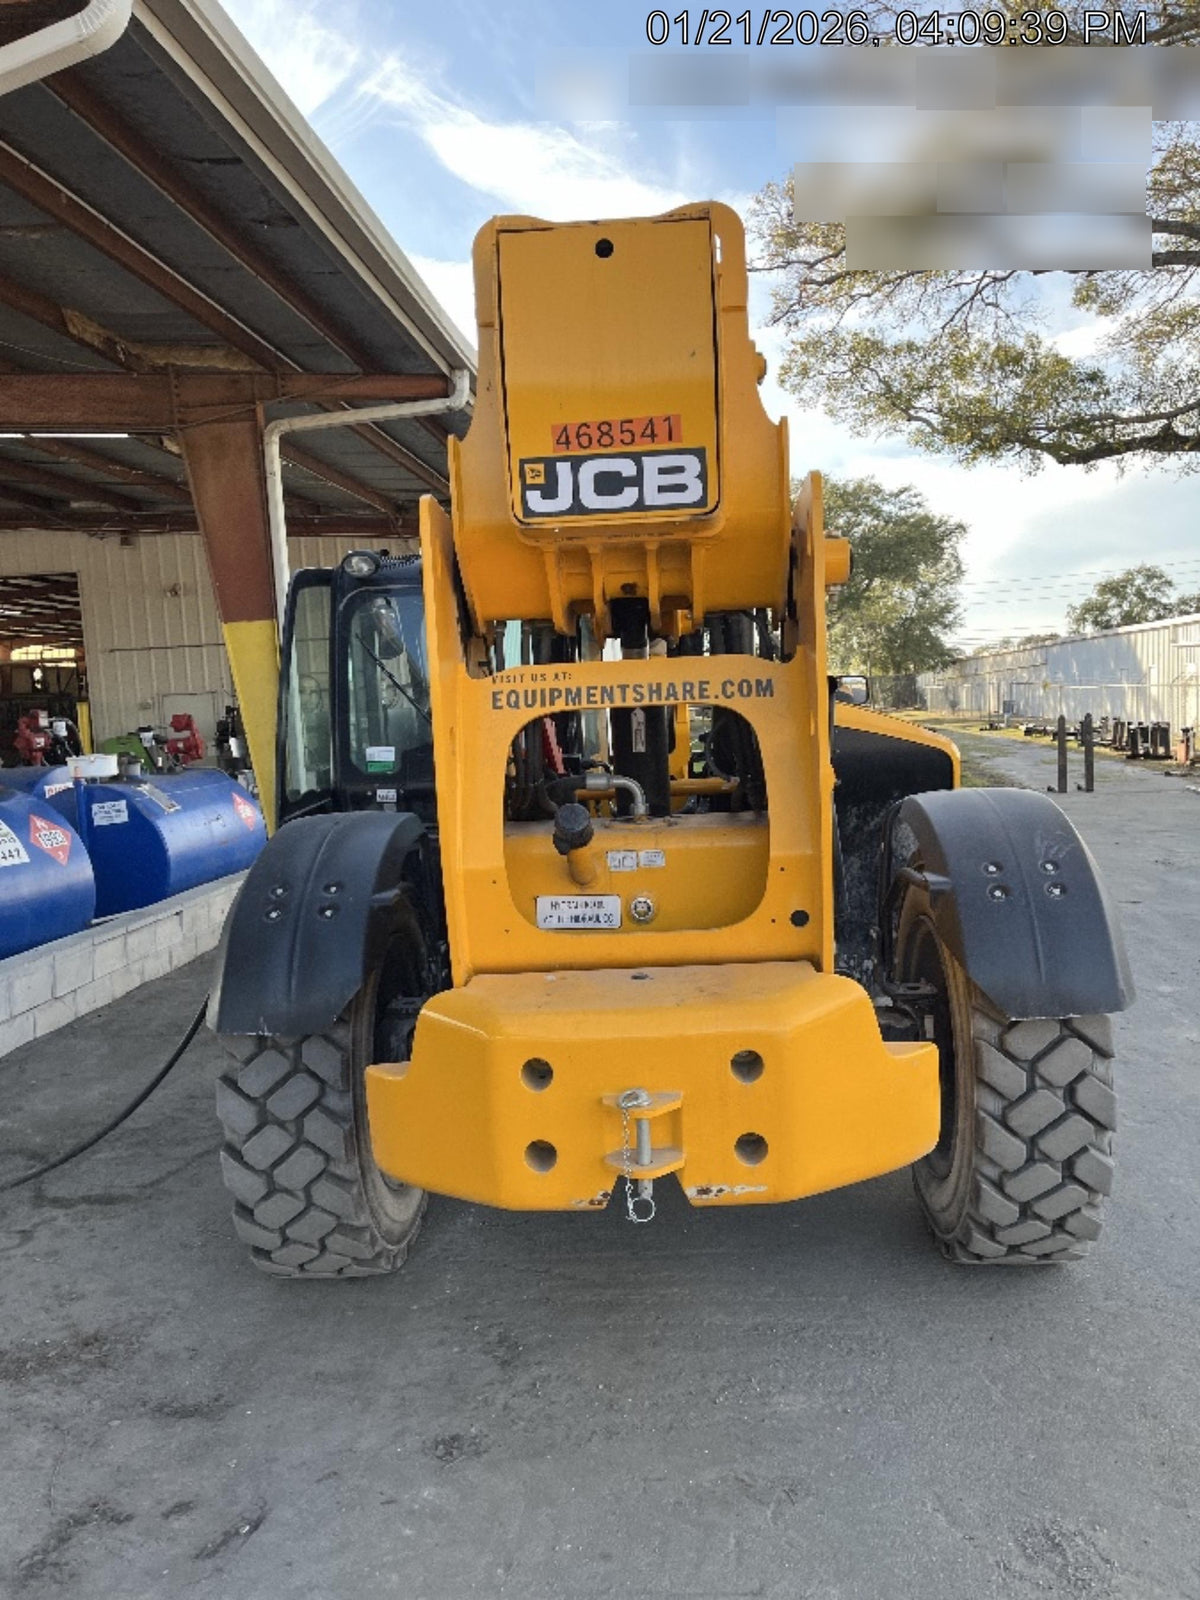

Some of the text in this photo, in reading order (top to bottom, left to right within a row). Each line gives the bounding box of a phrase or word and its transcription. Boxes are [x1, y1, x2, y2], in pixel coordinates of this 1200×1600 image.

[556, 415, 674, 450] 468541
[526, 454, 704, 513] JCB
[492, 671, 572, 685] VISIT US AT:
[492, 678, 775, 710] EQUIPMENTSHARE.COM
